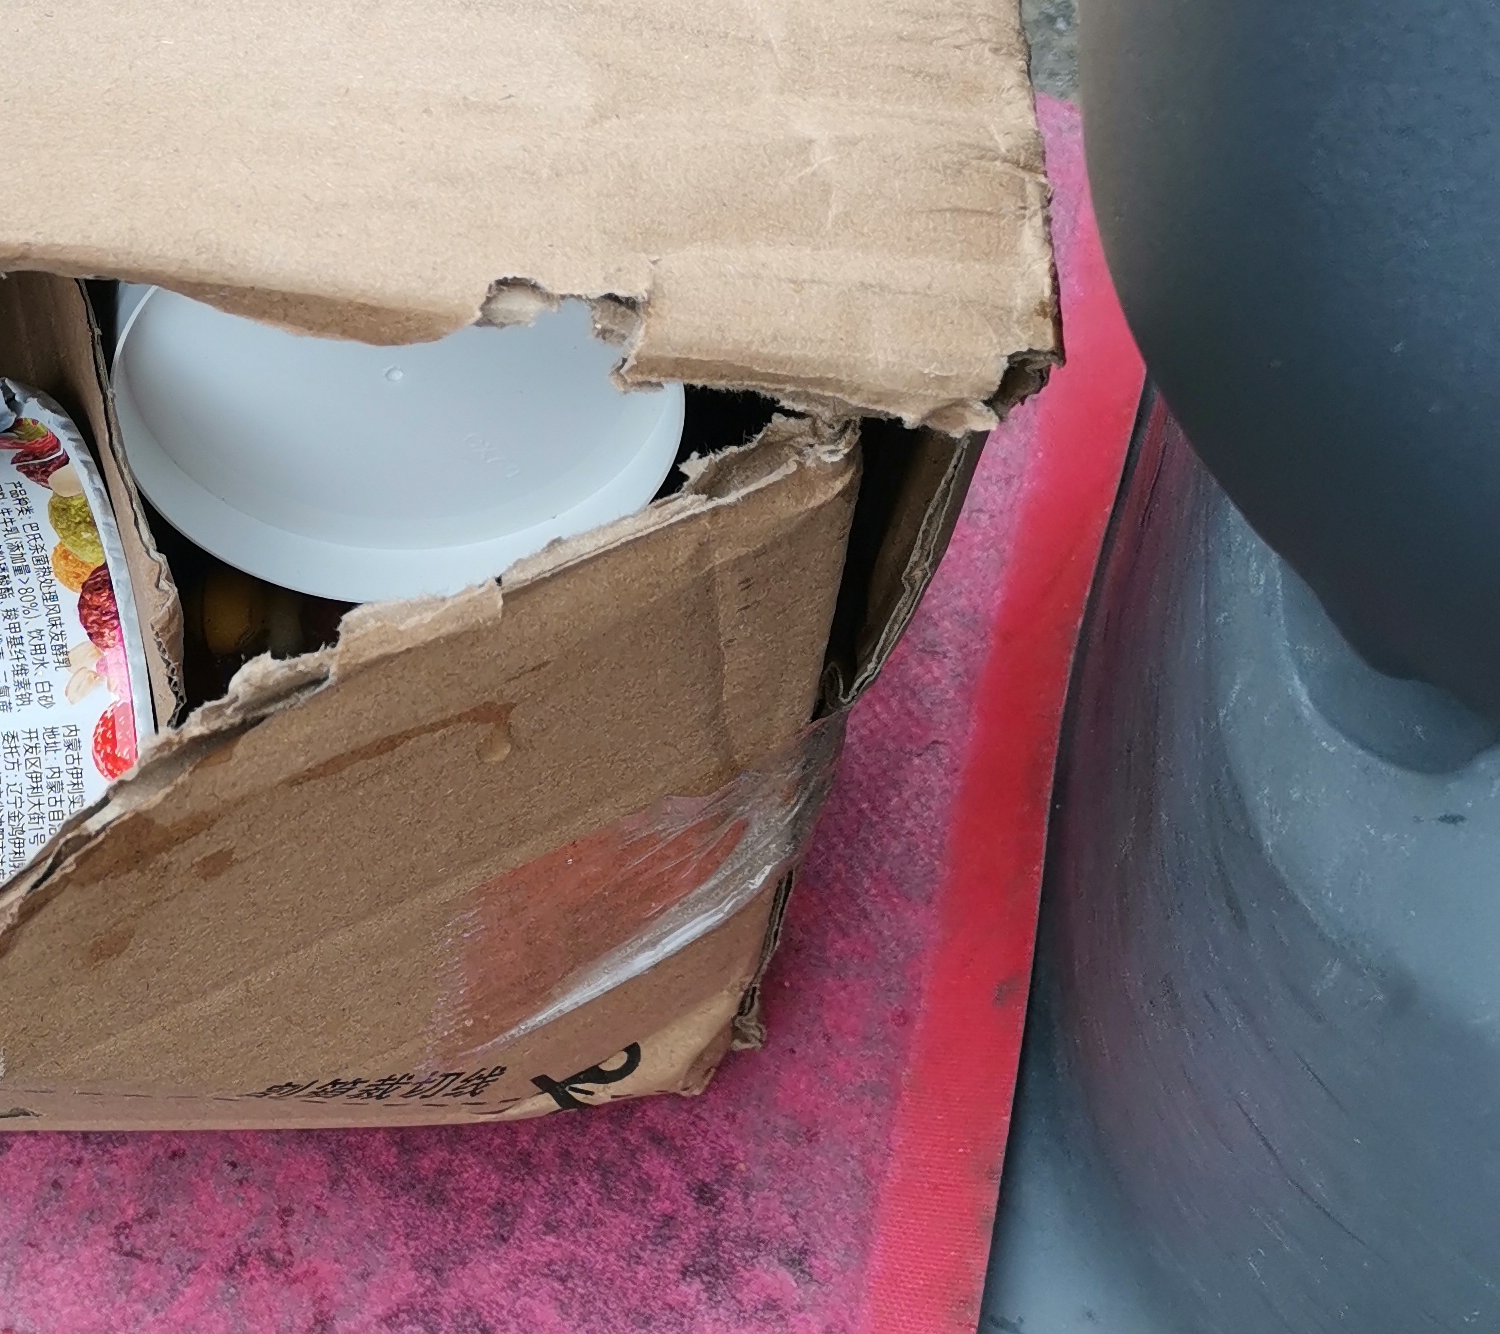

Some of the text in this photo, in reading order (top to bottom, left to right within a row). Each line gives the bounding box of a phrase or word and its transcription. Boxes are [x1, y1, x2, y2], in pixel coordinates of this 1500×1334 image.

[61, 722, 85, 815] 内蒙古伊利实
